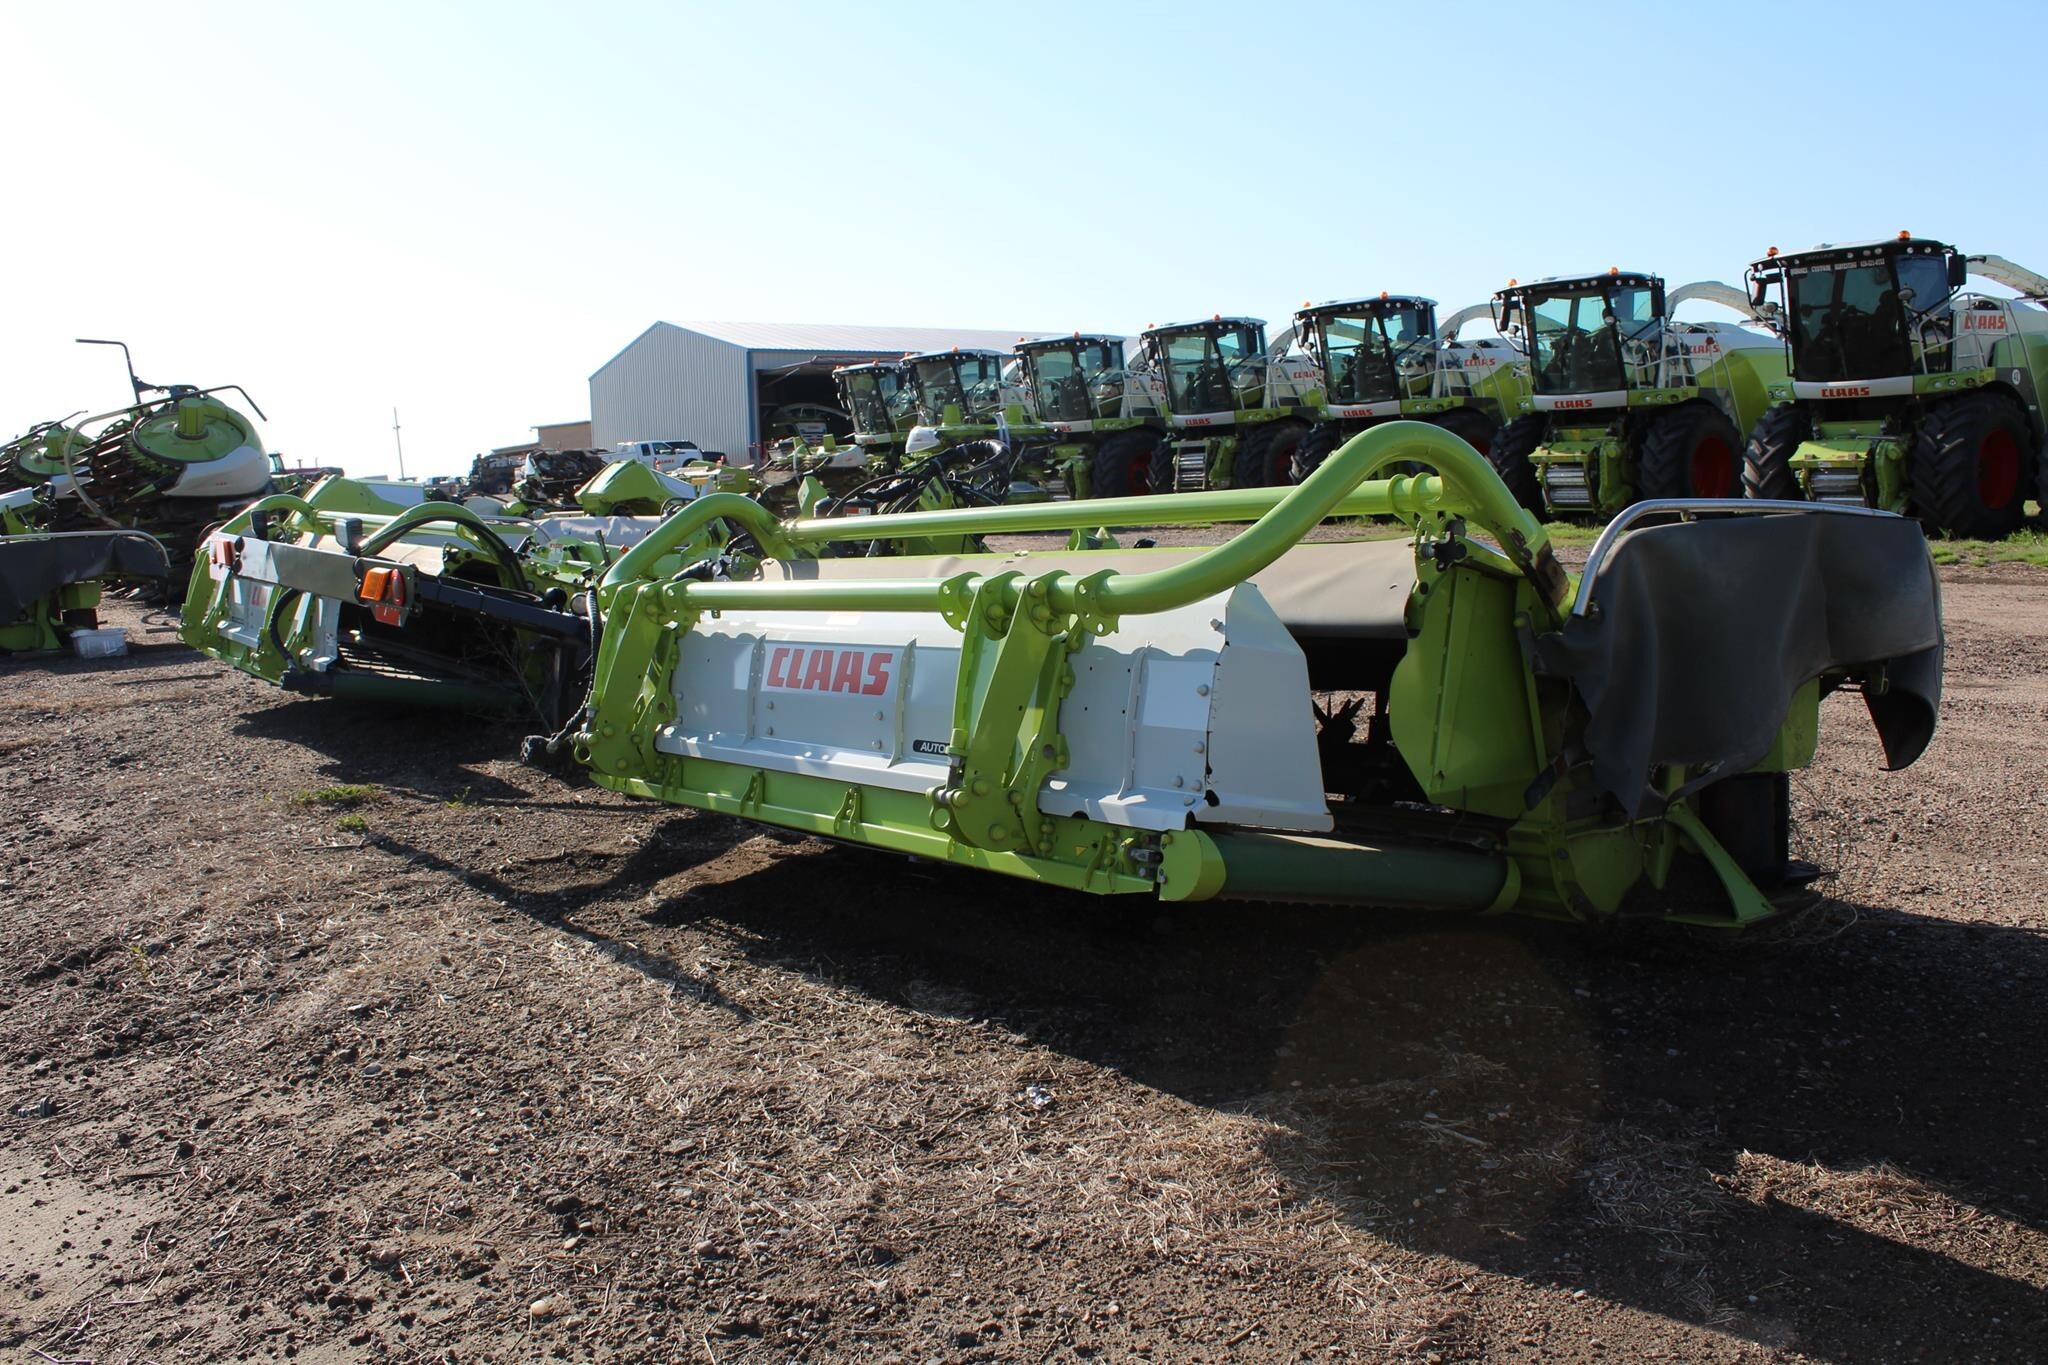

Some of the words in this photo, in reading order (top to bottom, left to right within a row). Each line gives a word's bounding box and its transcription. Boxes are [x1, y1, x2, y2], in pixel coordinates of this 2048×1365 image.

[1964, 315, 2006, 330] CAAS
[1821, 387, 1870, 397] CLAAS
[1554, 399, 1593, 409] CLAAS
[1343, 409, 1374, 417] CLAAS
[767, 647, 893, 696] CLAAS
